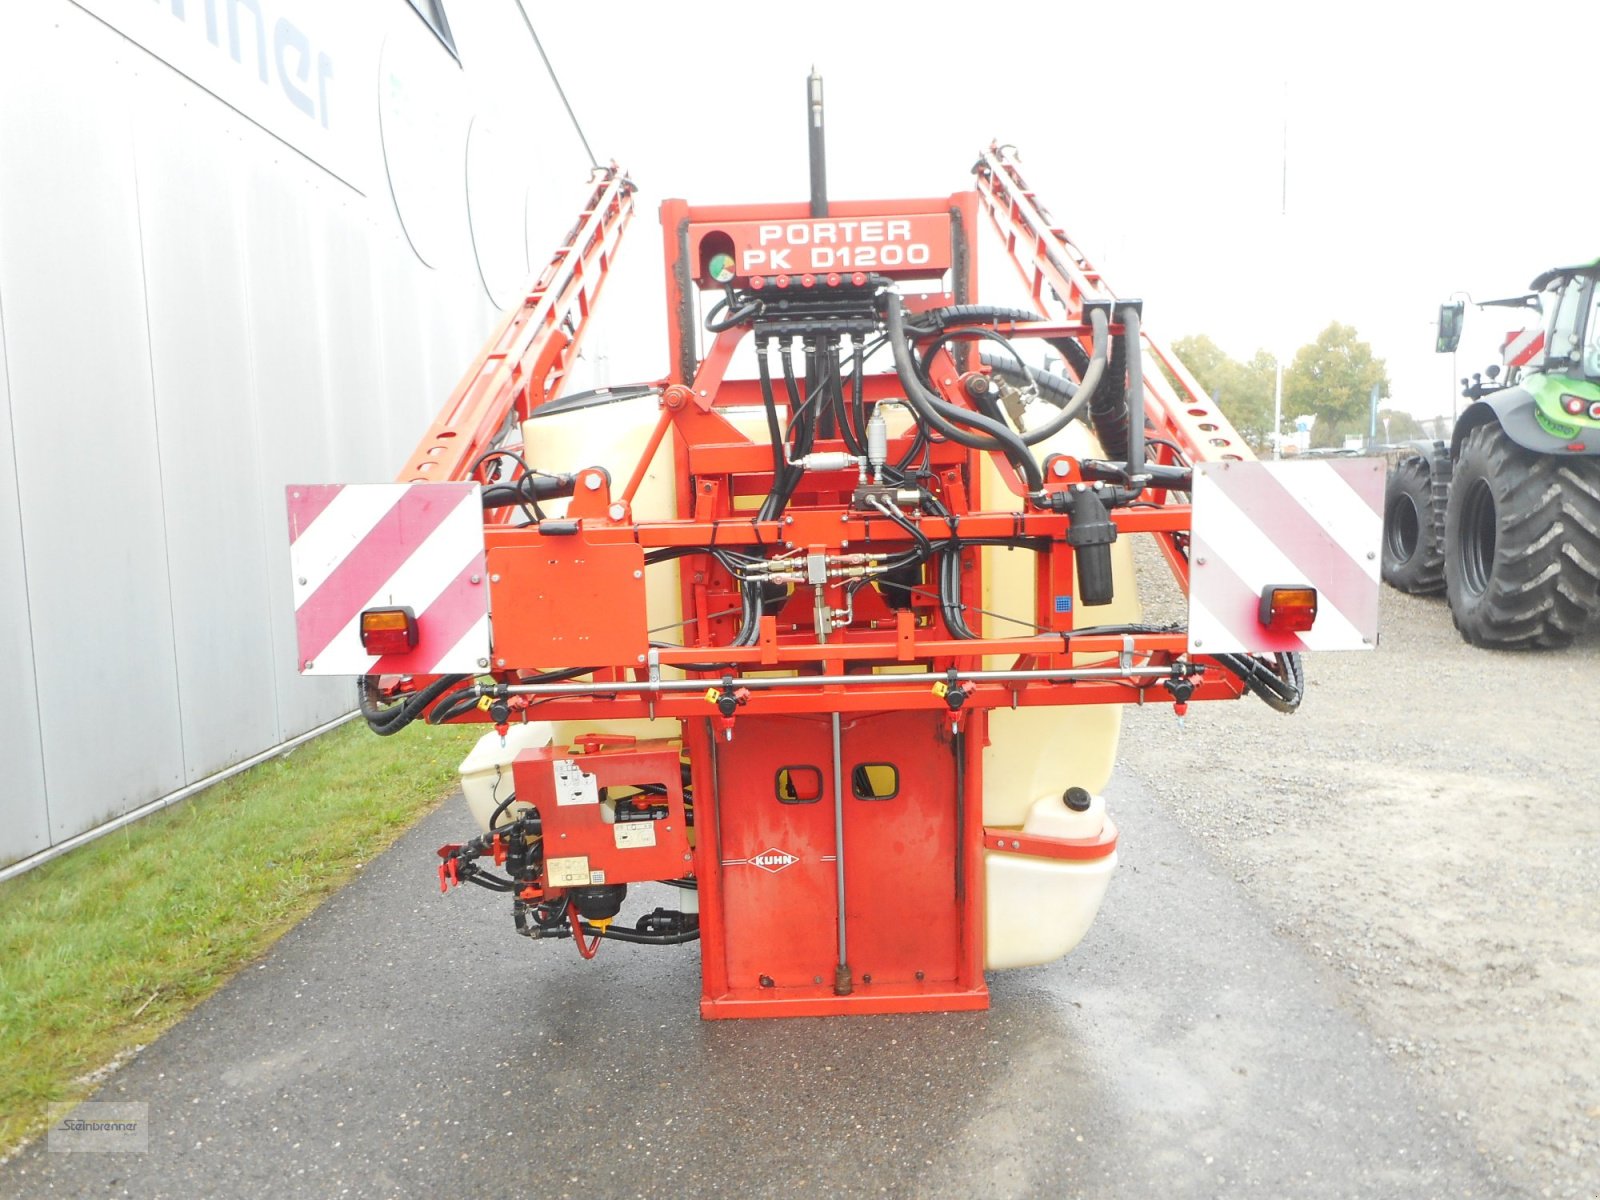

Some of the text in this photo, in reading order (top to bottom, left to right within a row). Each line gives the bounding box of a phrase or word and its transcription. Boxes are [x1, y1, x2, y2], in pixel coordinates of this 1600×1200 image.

[759, 219, 912, 246] PORTER
[743, 243, 930, 271] PK D1200
[755, 855, 792, 866] KUHN
